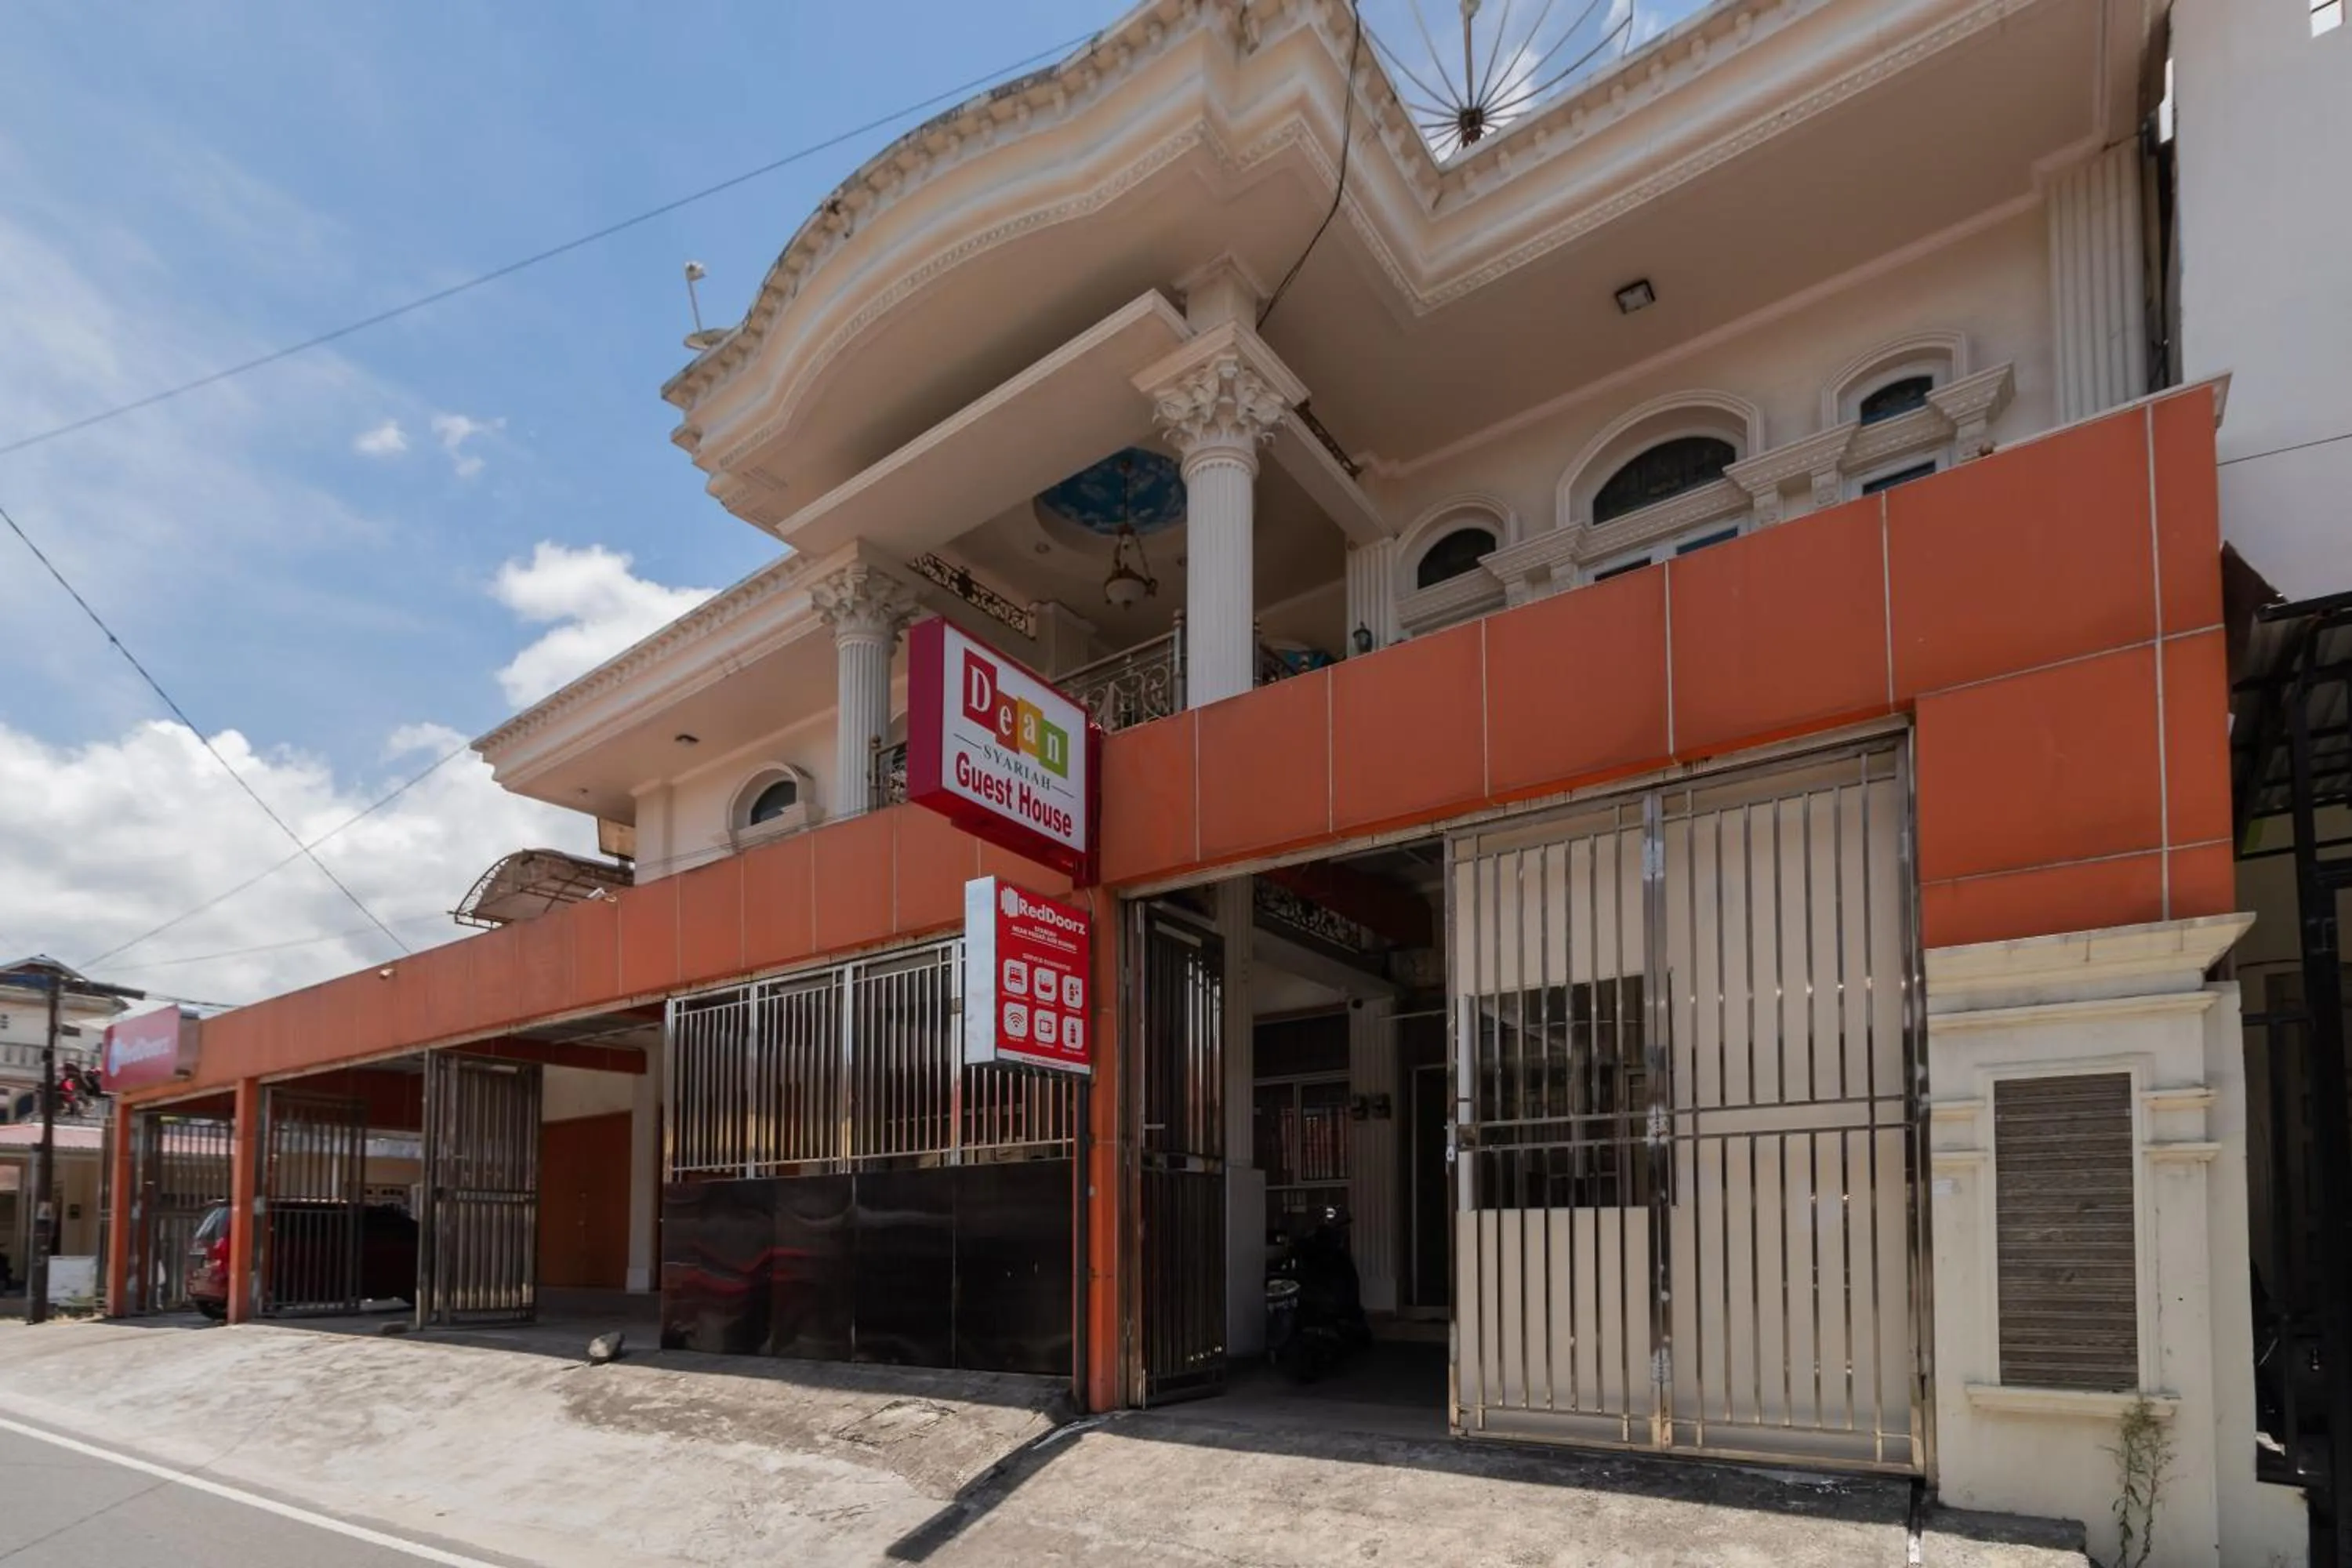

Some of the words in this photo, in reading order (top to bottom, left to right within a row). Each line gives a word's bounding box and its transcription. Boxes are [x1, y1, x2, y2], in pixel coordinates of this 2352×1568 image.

[969, 664, 1061, 766] Dean
[956, 751, 1012, 810] Guest
[1019, 786, 1072, 837] House
[982, 746, 1051, 791] SYARIAH
[1018, 897, 1086, 935] RedDoorz
